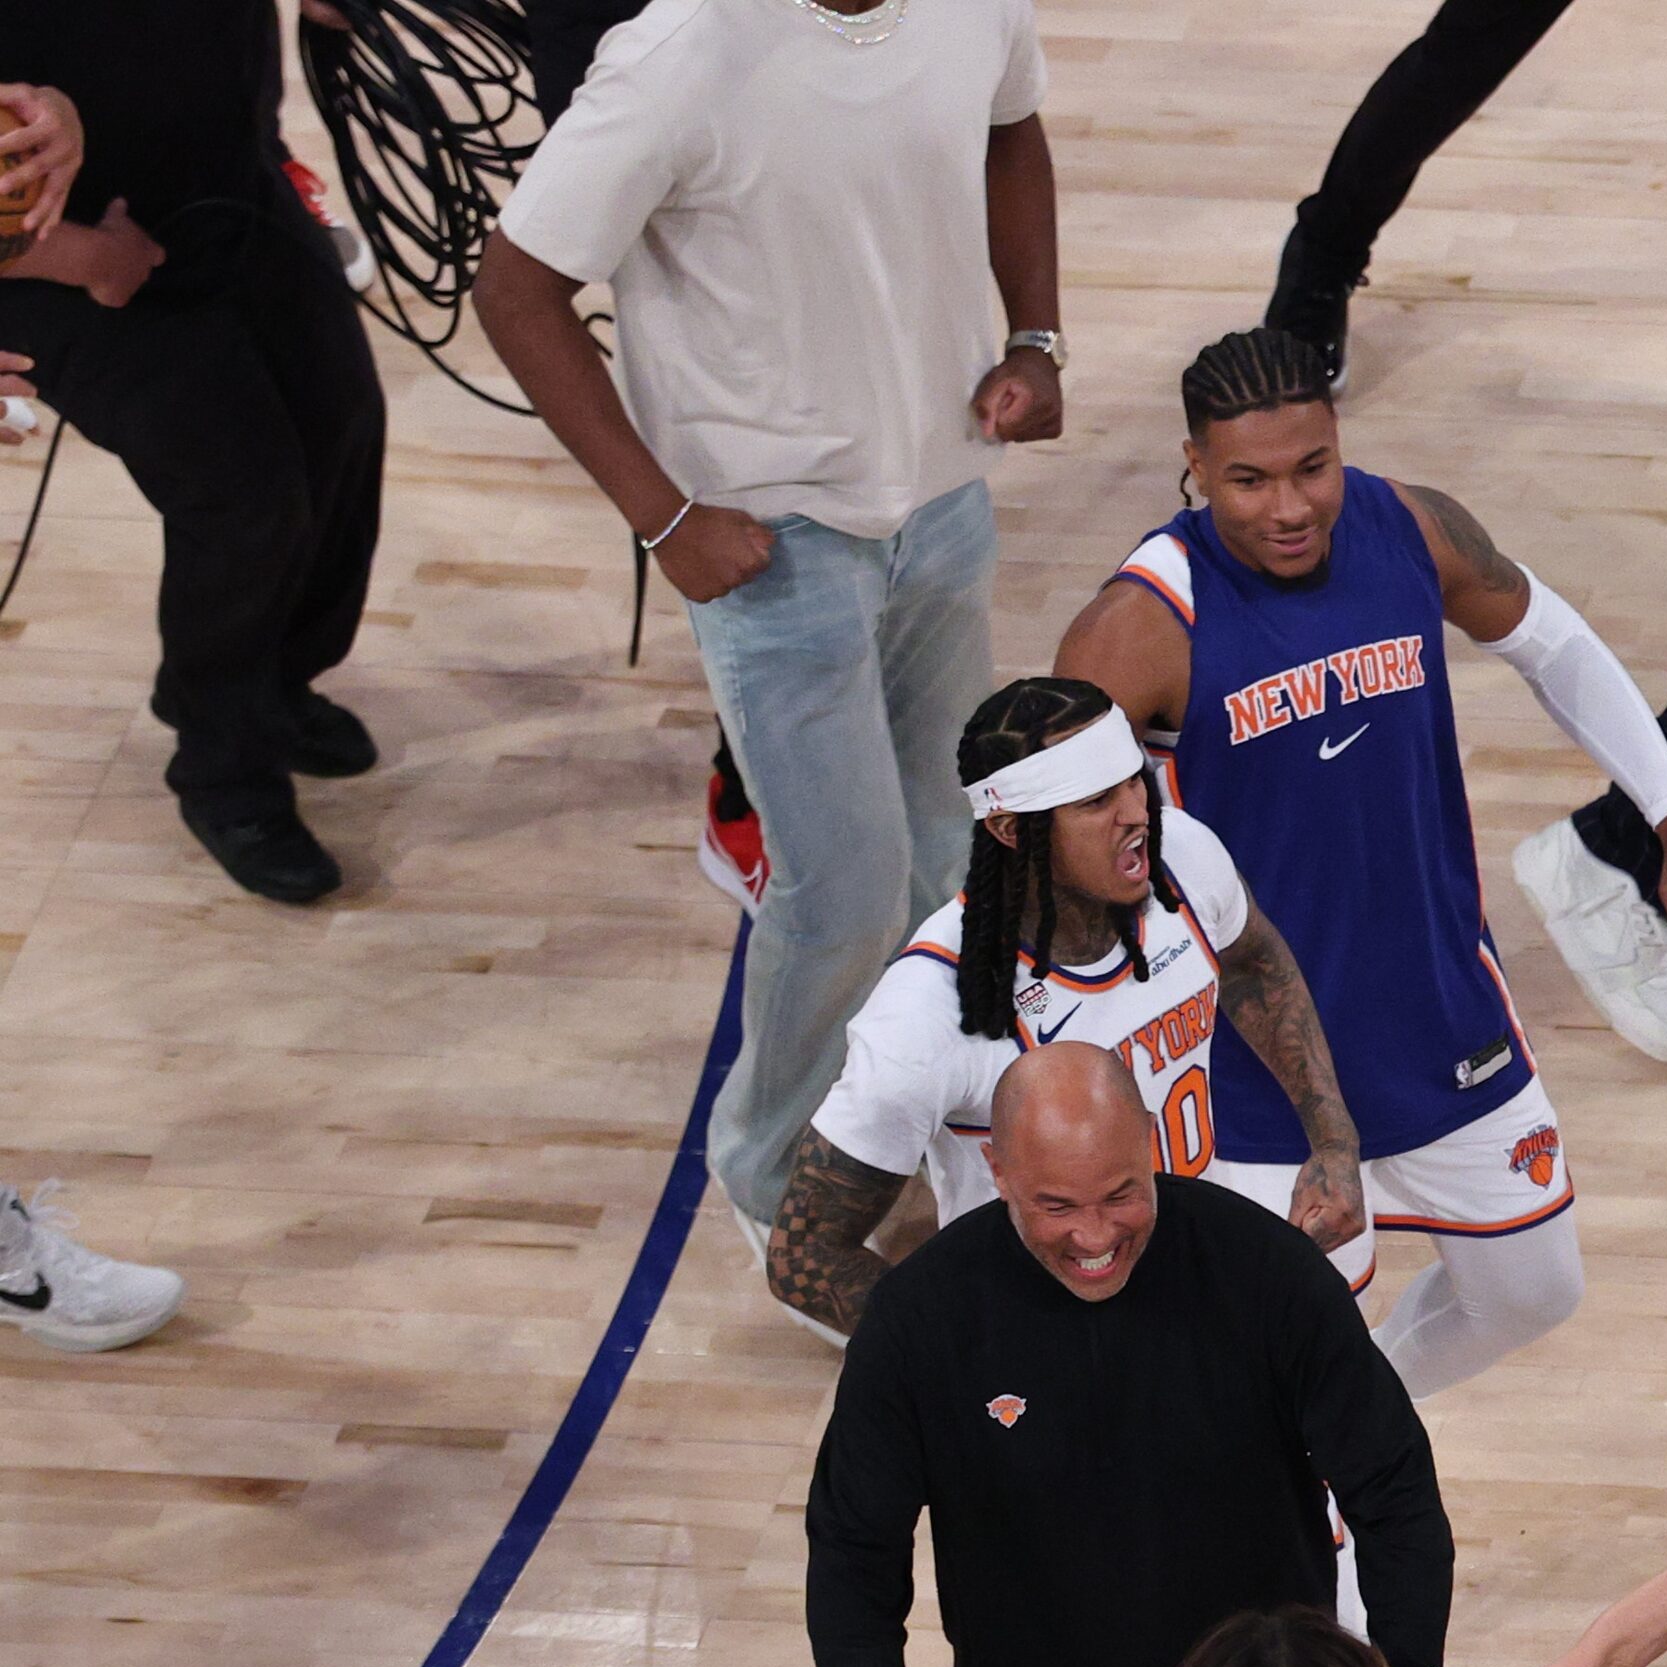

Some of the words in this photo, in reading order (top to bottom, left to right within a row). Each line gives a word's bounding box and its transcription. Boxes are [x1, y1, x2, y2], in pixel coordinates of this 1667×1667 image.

[1223, 657, 1326, 746] NEW
[1327, 635, 1425, 706] YORK
[1018, 984, 1045, 1004] USA
[1133, 980, 1217, 1077] YORK
[1152, 1064, 1215, 1178] 0
